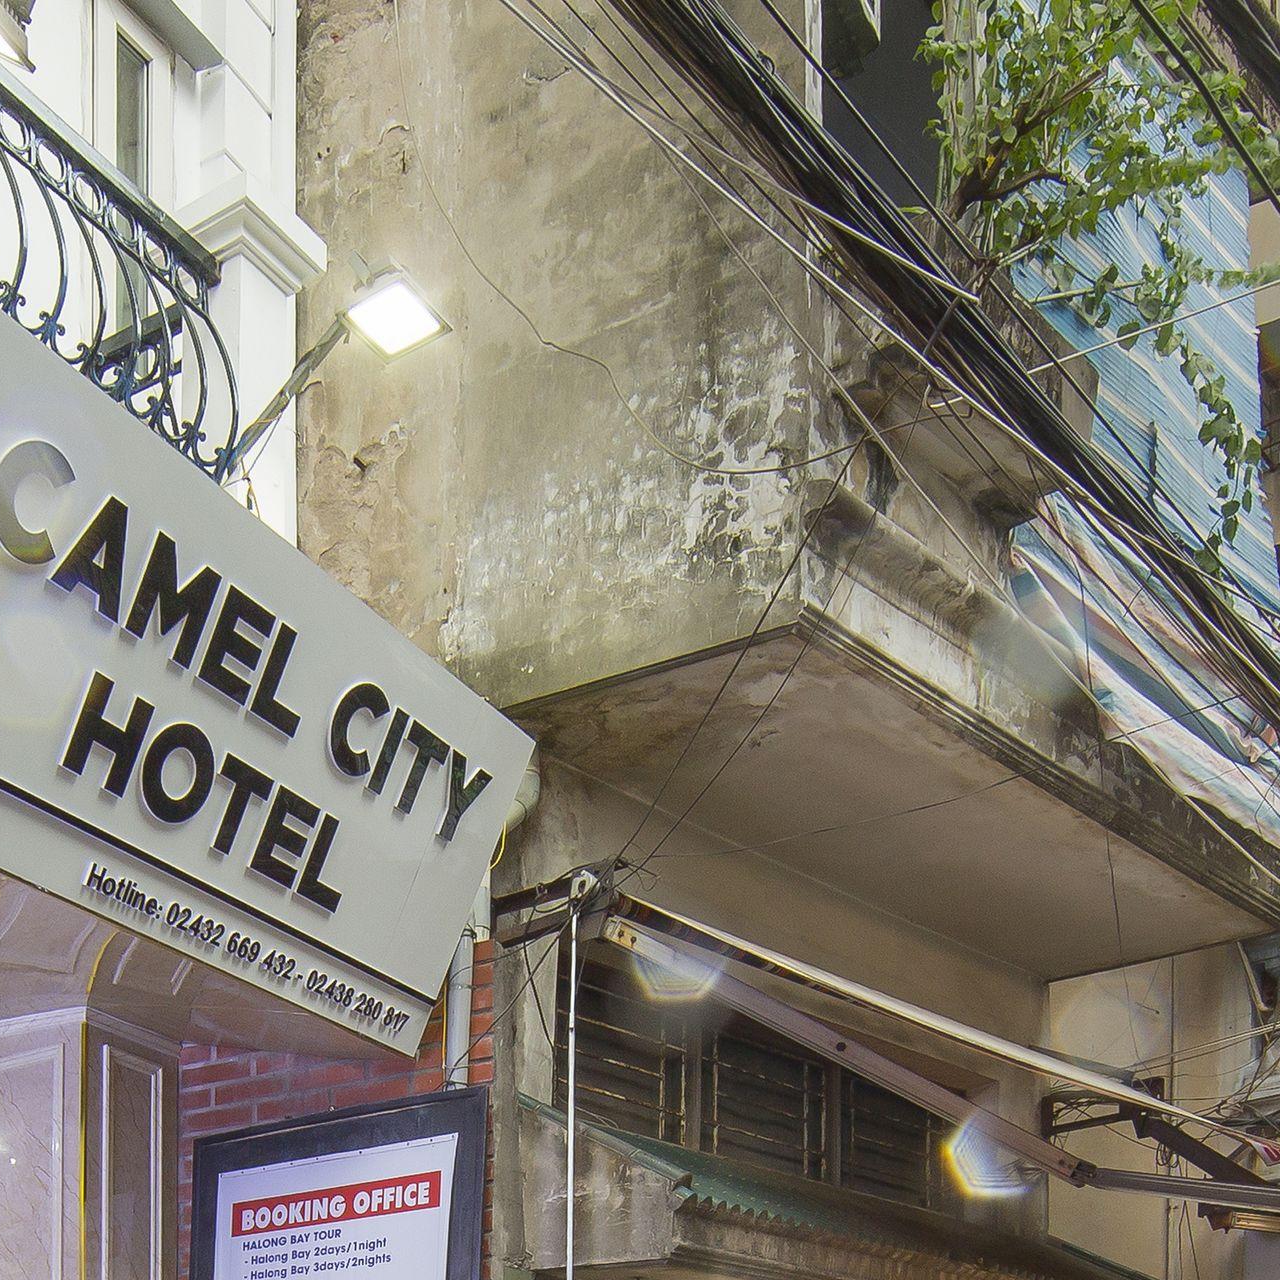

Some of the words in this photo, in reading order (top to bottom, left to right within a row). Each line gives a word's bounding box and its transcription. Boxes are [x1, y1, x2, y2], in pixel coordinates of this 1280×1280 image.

[328, 681, 493, 841] CITY
[60, 670, 342, 914] HOTEL
[85, 863, 163, 919] Hotline:
[166, 903, 224, 948] 02432
[227, 933, 261, 963] 669
[263, 950, 296, 980] 432
[307, 971, 353, 1007] 02438
[355, 994, 383, 1020] 280
[383, 1007, 410, 1032] 817
[241, 1195, 346, 1231] BOOKING
[353, 1181, 430, 1214] OFFICE
[243, 1237, 287, 1251] HALONG
[291, 1233, 310, 1244] BAY
[314, 1229, 342, 1241] TOUR
[251, 1253, 288, 1266] Halong
[291, 1249, 311, 1260] Bay
[314, 1238, 387, 1257] 2days/1night
[250, 1268, 287, 1280] Halong
[291, 1264, 310, 1276] Bay
[313, 1254, 391, 1272] 3days/2nights
